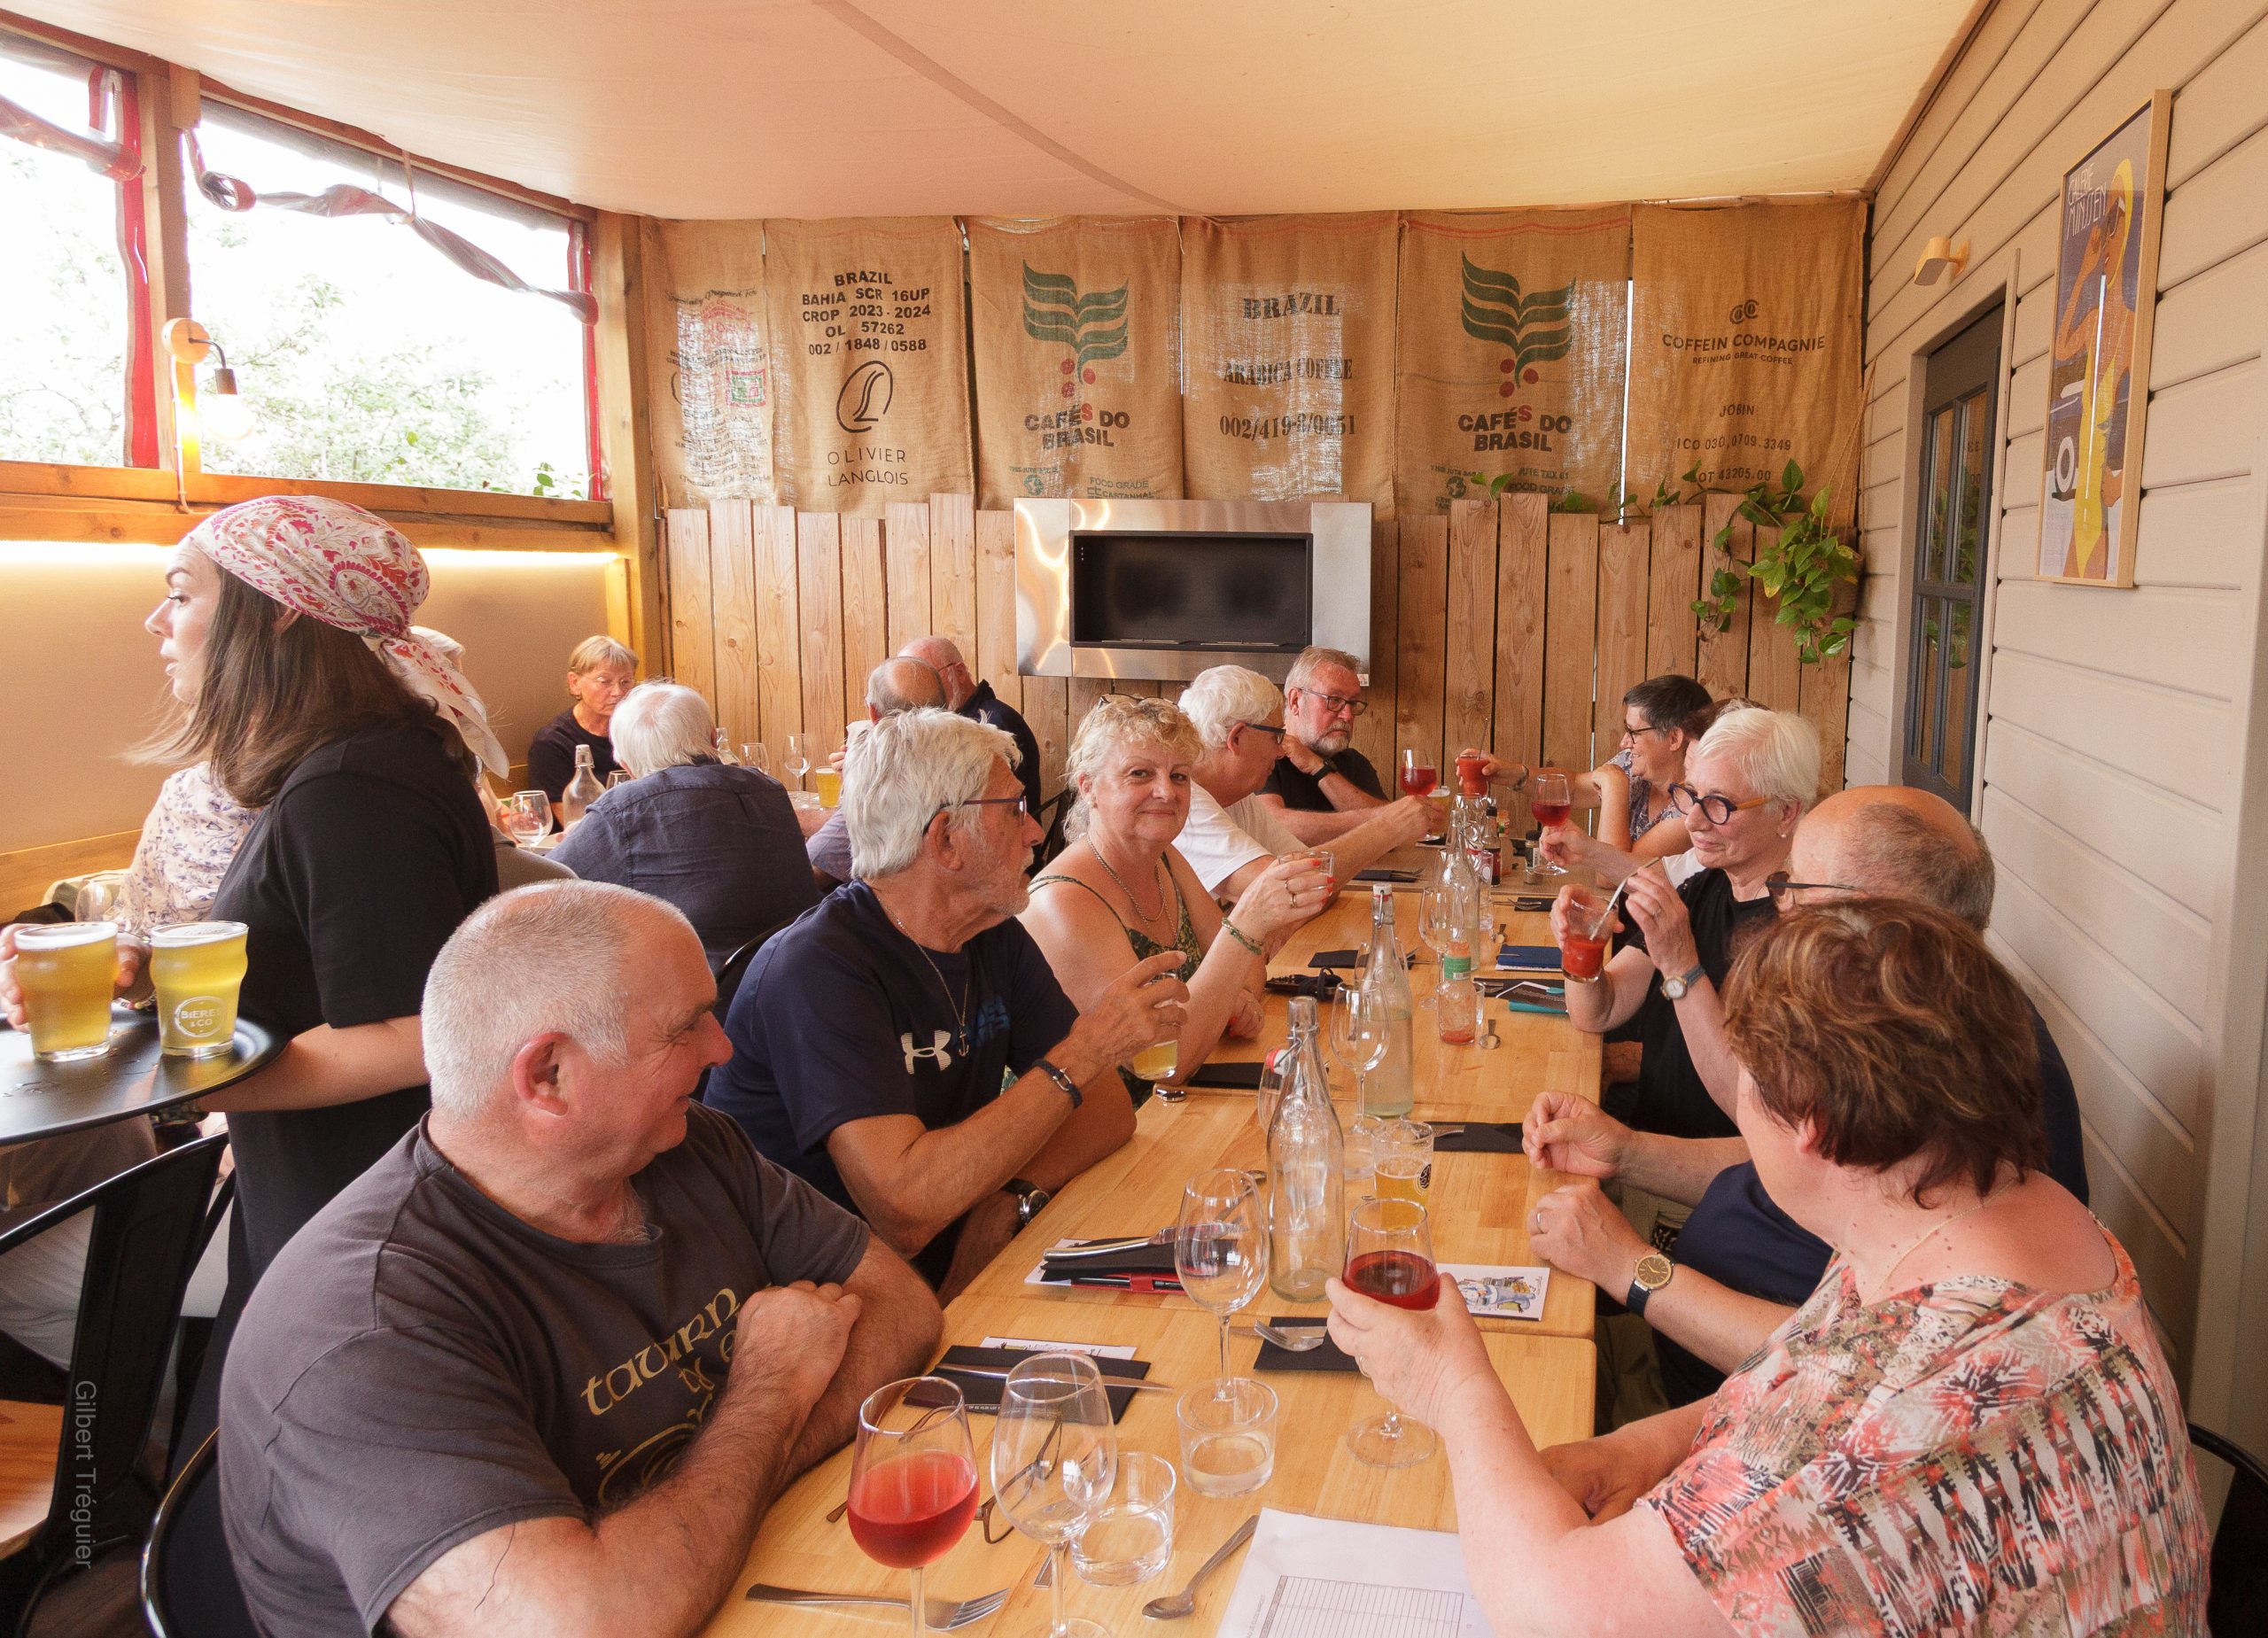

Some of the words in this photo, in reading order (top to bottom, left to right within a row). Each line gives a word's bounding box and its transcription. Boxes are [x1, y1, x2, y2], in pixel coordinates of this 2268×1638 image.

[834, 270, 893, 287] BRAZIL
[802, 291, 847, 306] BAHIA
[855, 287, 883, 301] SCR
[891, 287, 930, 302] 16UP
[803, 309, 840, 322] CROP
[849, 304, 883, 318] 2023
[894, 304, 931, 319] 2024
[1242, 292, 1340, 321] BRAZIL
[825, 325, 846, 338] OL
[860, 321, 905, 335] 57262
[1661, 333, 1728, 352] COFFEIN
[1732, 333, 1826, 353] COMPAGNIE
[1692, 353, 1731, 365] REFINING
[1734, 351, 1759, 361] GREAT
[1760, 354, 1793, 365] COFFEE
[1099, 409, 1130, 429] DO
[1719, 403, 1755, 417] JOBIN
[1540, 415, 1572, 433] DO
[1042, 426, 1115, 450] BRASIL
[1473, 431, 1553, 452] BRASIL
[827, 447, 906, 465] OLIVIER
[827, 470, 908, 487] LANGLOIS
[1090, 477, 1114, 487] FOOD
[1115, 479, 1150, 490] GRADE
[1690, 470, 1715, 484] OT
